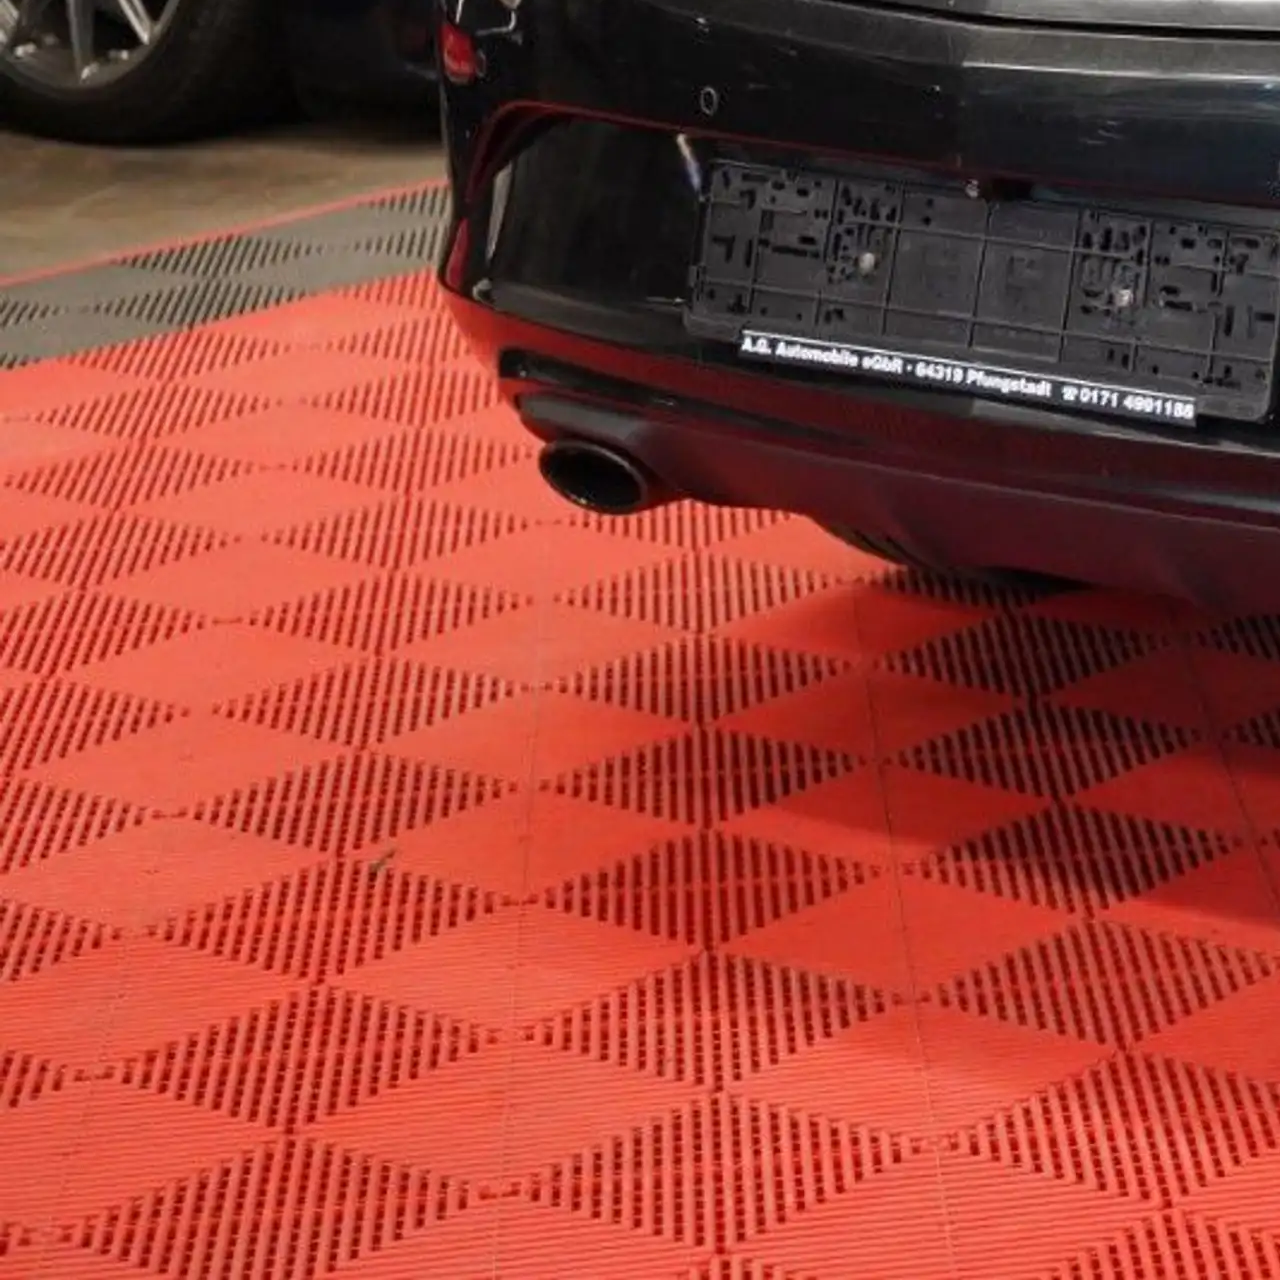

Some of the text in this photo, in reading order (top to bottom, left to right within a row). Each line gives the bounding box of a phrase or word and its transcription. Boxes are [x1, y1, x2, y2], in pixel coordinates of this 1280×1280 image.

[775, 341, 859, 368] Automobile
[914, 361, 964, 383] 64319
[965, 368, 1052, 398] Pfungstadt
[1079, 387, 1119, 408] 0171
